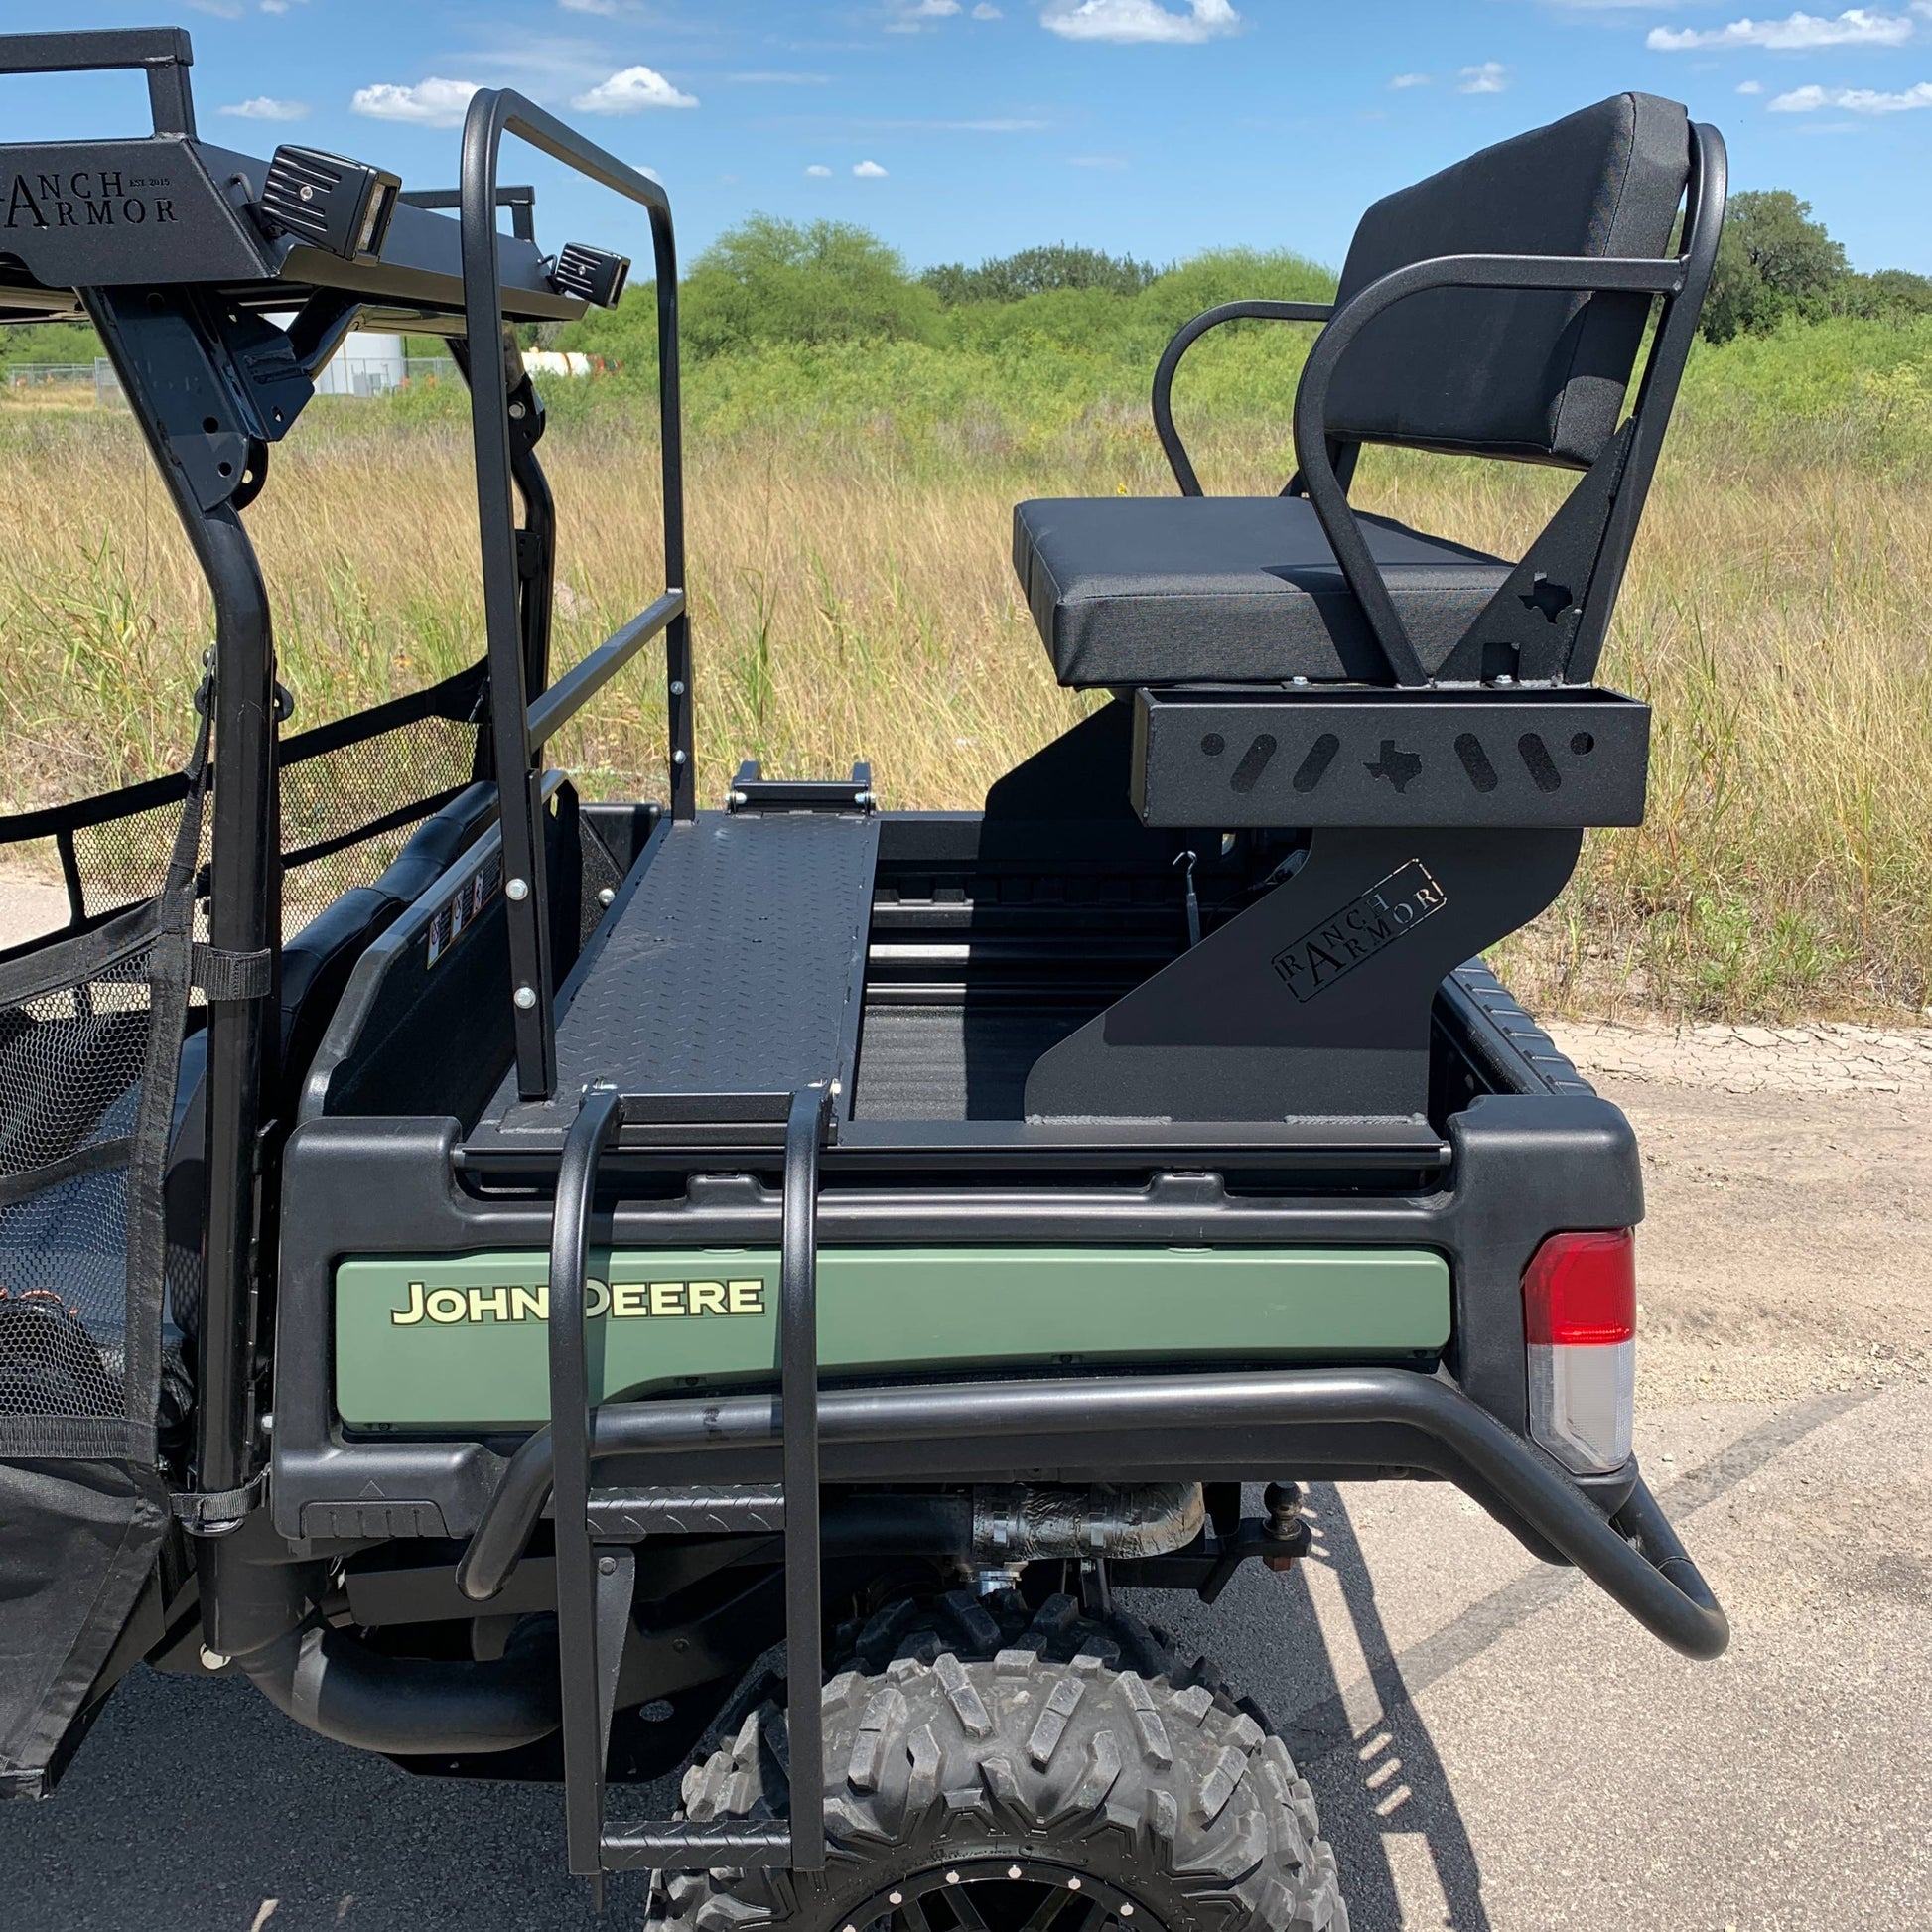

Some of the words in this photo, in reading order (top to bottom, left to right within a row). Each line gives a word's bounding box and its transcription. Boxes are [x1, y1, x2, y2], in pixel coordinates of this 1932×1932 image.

[0, 172, 125, 227] ANCH
[4, 174, 179, 227] ARMOR
[1279, 893, 1390, 986] RANCH
[1305, 888, 1440, 986] ARMOR
[390, 1281, 549, 1325] JOHN
